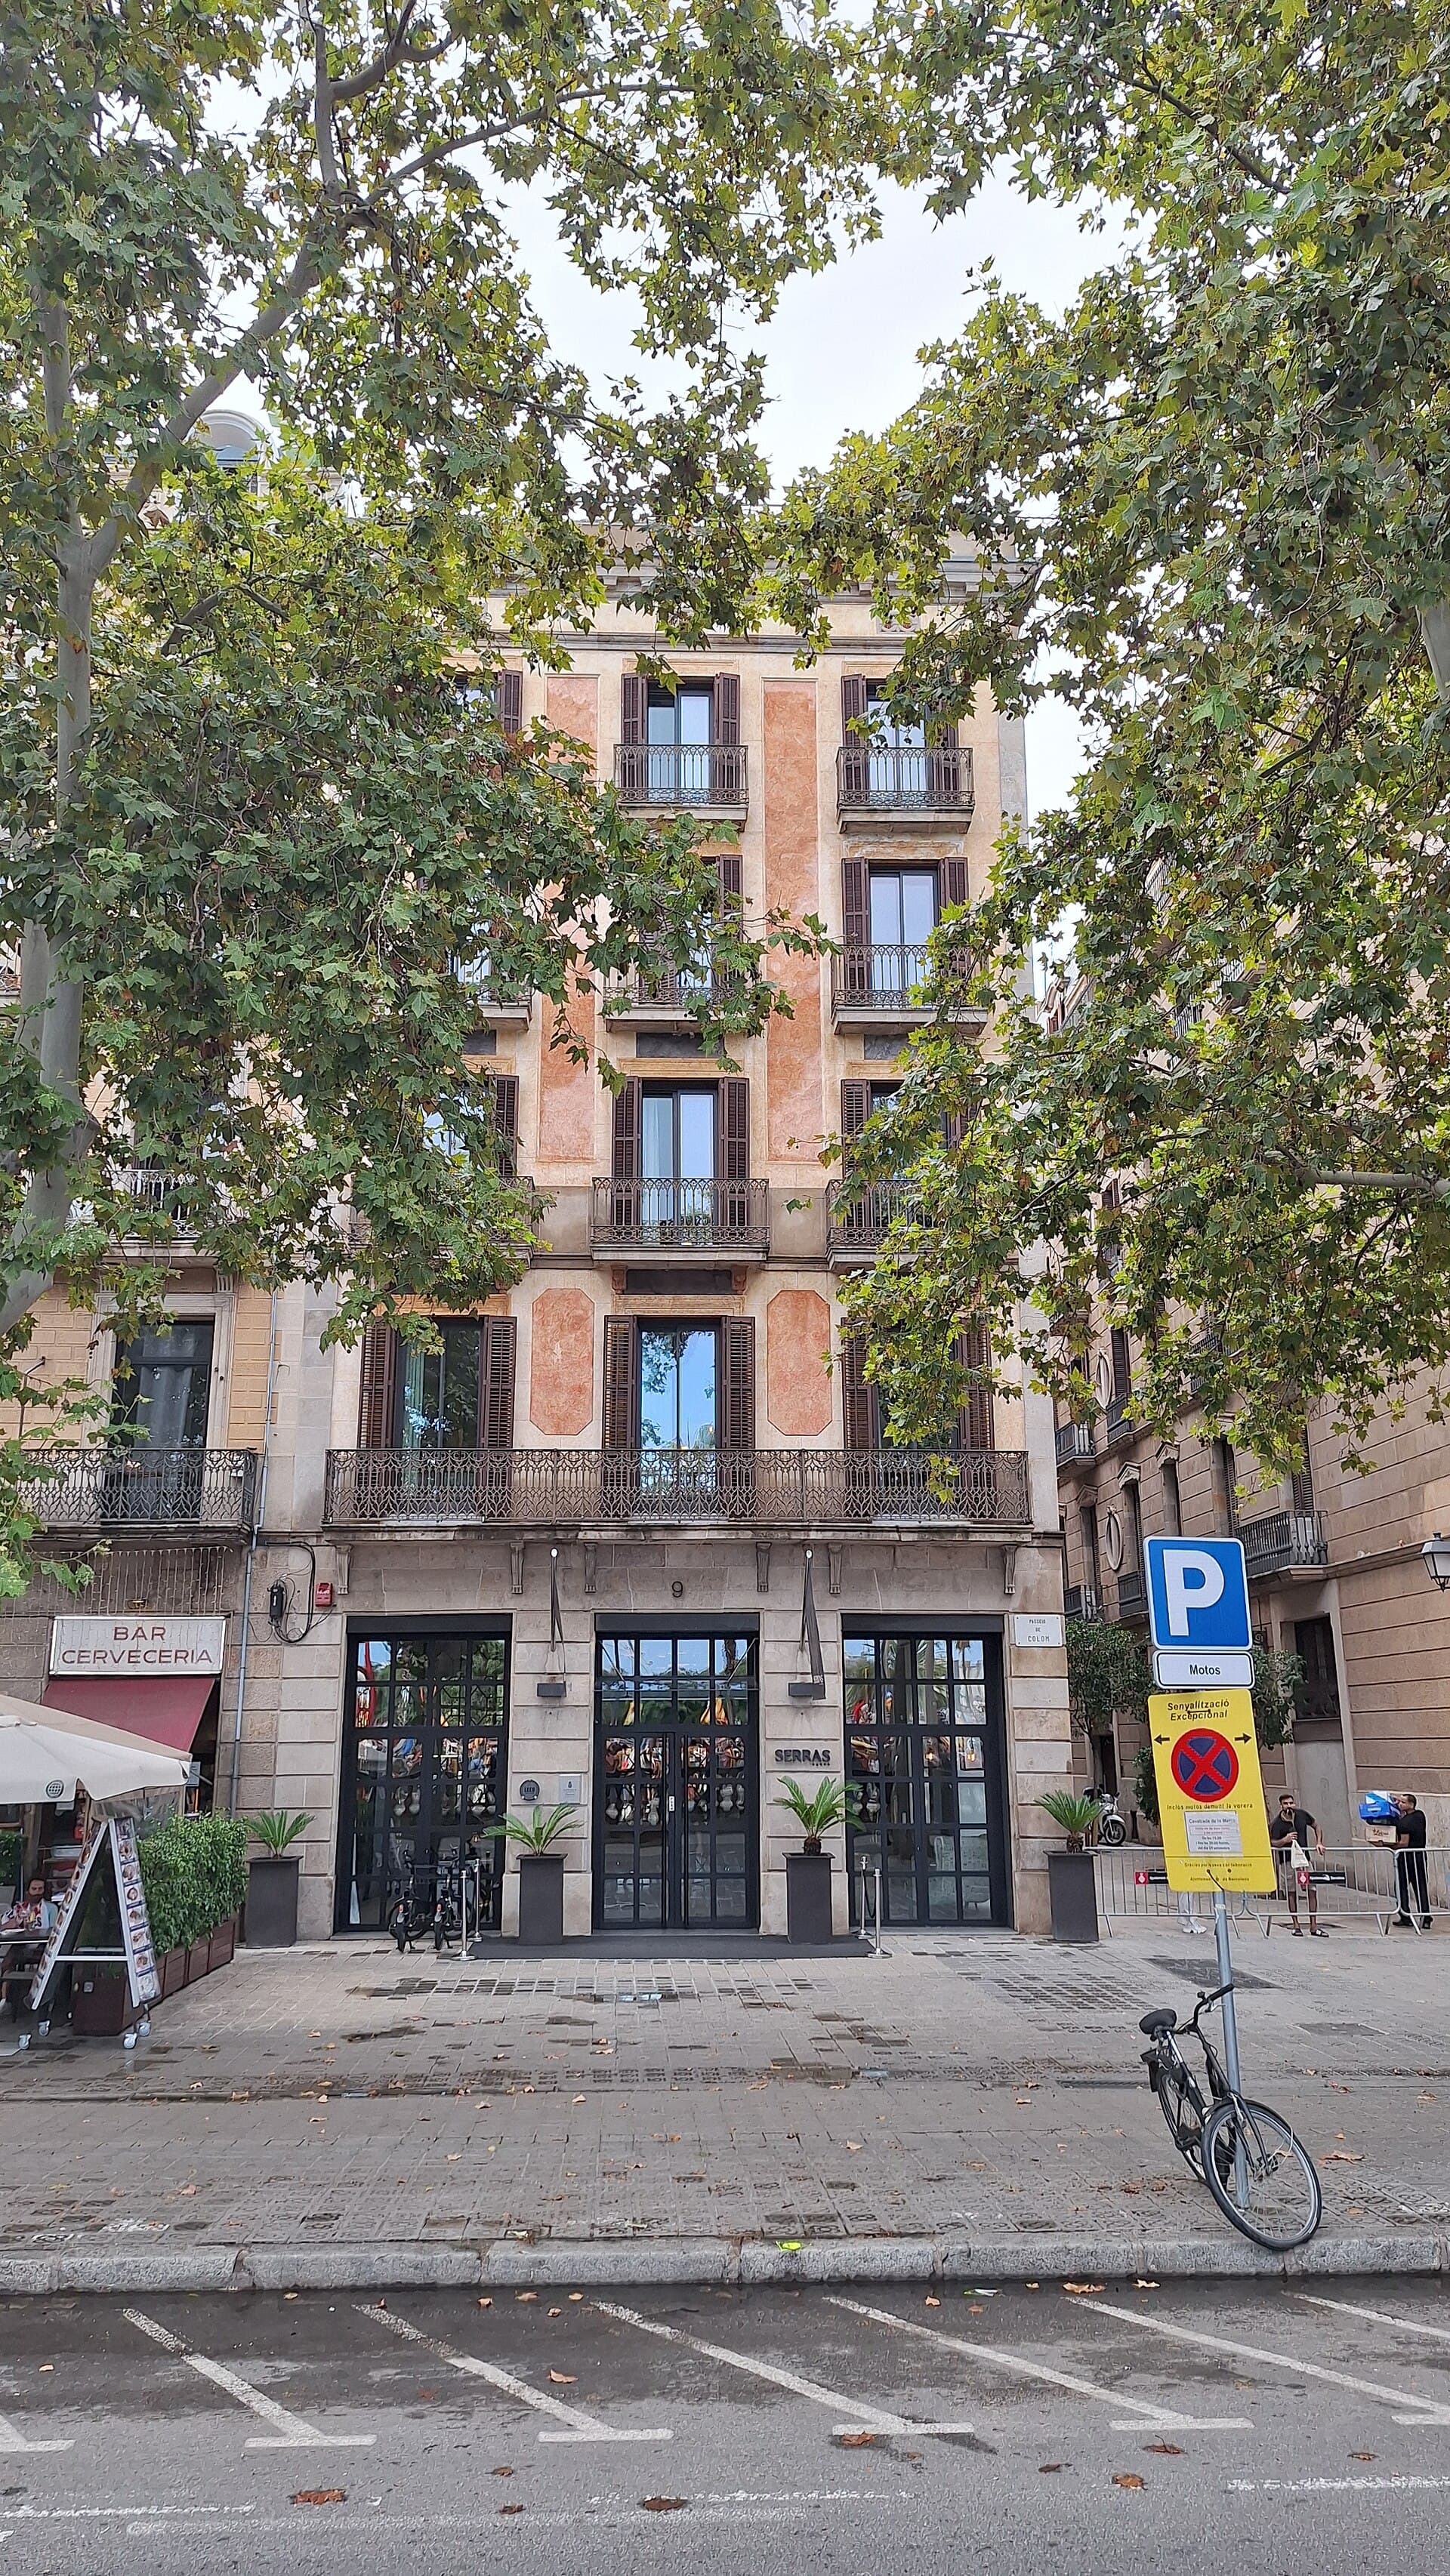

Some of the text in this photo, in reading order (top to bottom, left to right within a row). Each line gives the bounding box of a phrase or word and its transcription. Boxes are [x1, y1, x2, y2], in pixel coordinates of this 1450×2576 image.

[671, 1581, 683, 1598] 9
[1163, 1549, 1225, 1636] P
[113, 1627, 166, 1641] BAR
[62, 1650, 212, 1664] CERVECERIA
[1189, 1664, 1221, 1675] Motos
[1168, 1699, 1229, 1712] Senyalització
[1171, 1709, 1228, 1721] Excepcional
[775, 1749, 831, 1762] SERRAS
